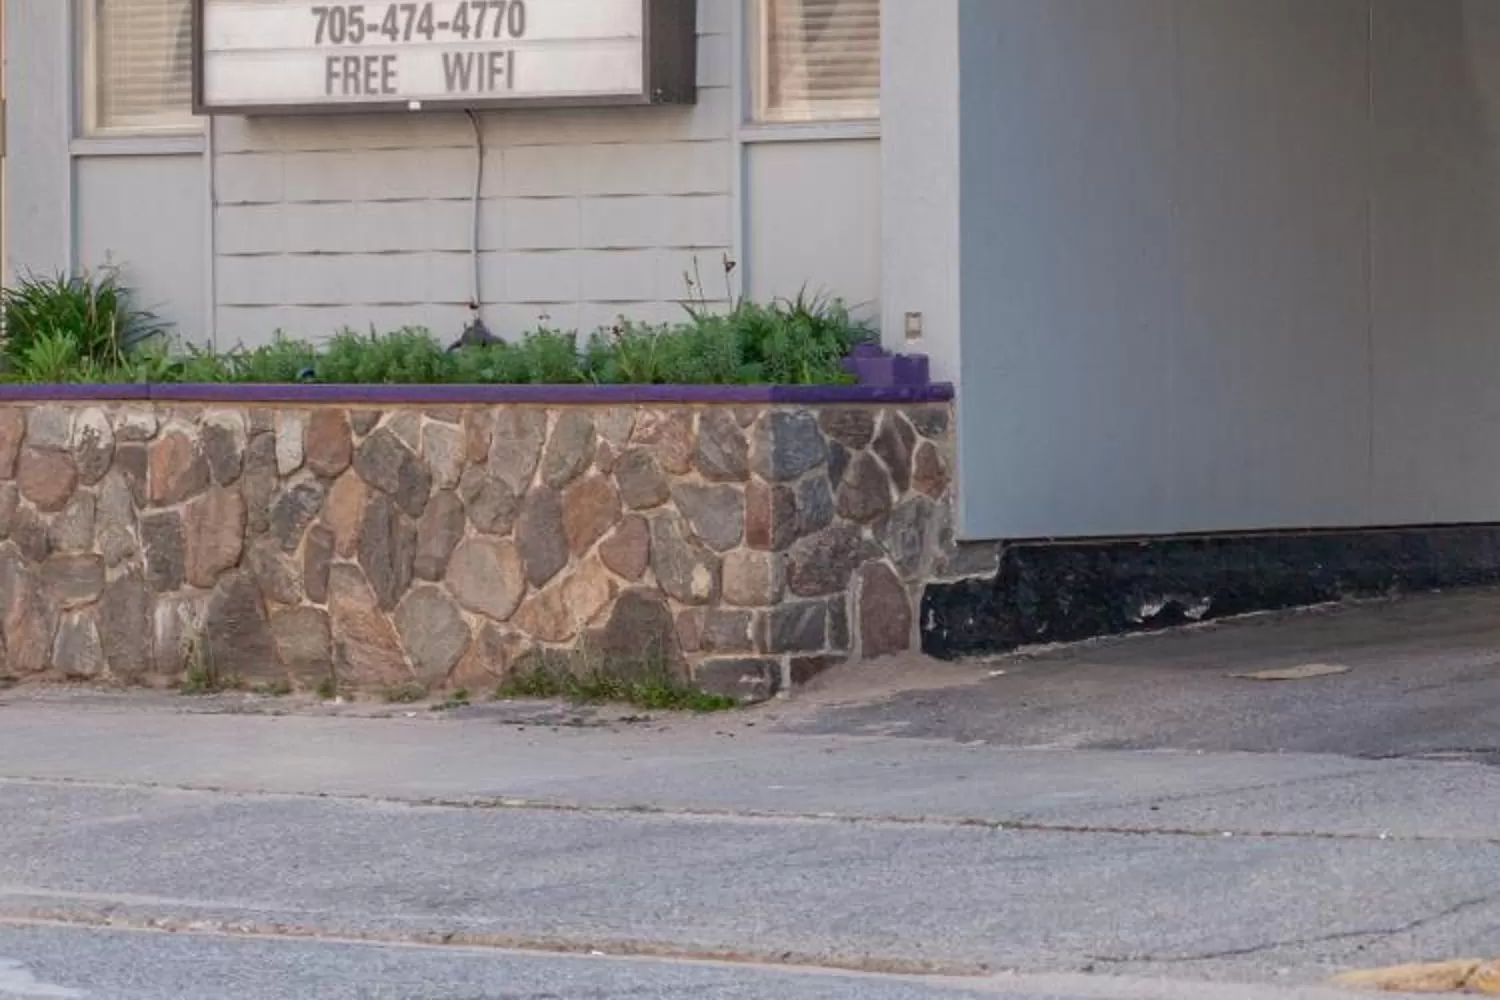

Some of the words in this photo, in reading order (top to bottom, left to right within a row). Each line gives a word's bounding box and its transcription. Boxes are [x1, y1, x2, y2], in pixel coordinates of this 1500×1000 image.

[311, 0, 527, 45] 705-474-4770
[325, 54, 398, 96] FREE
[442, 50, 515, 93] WIFI
